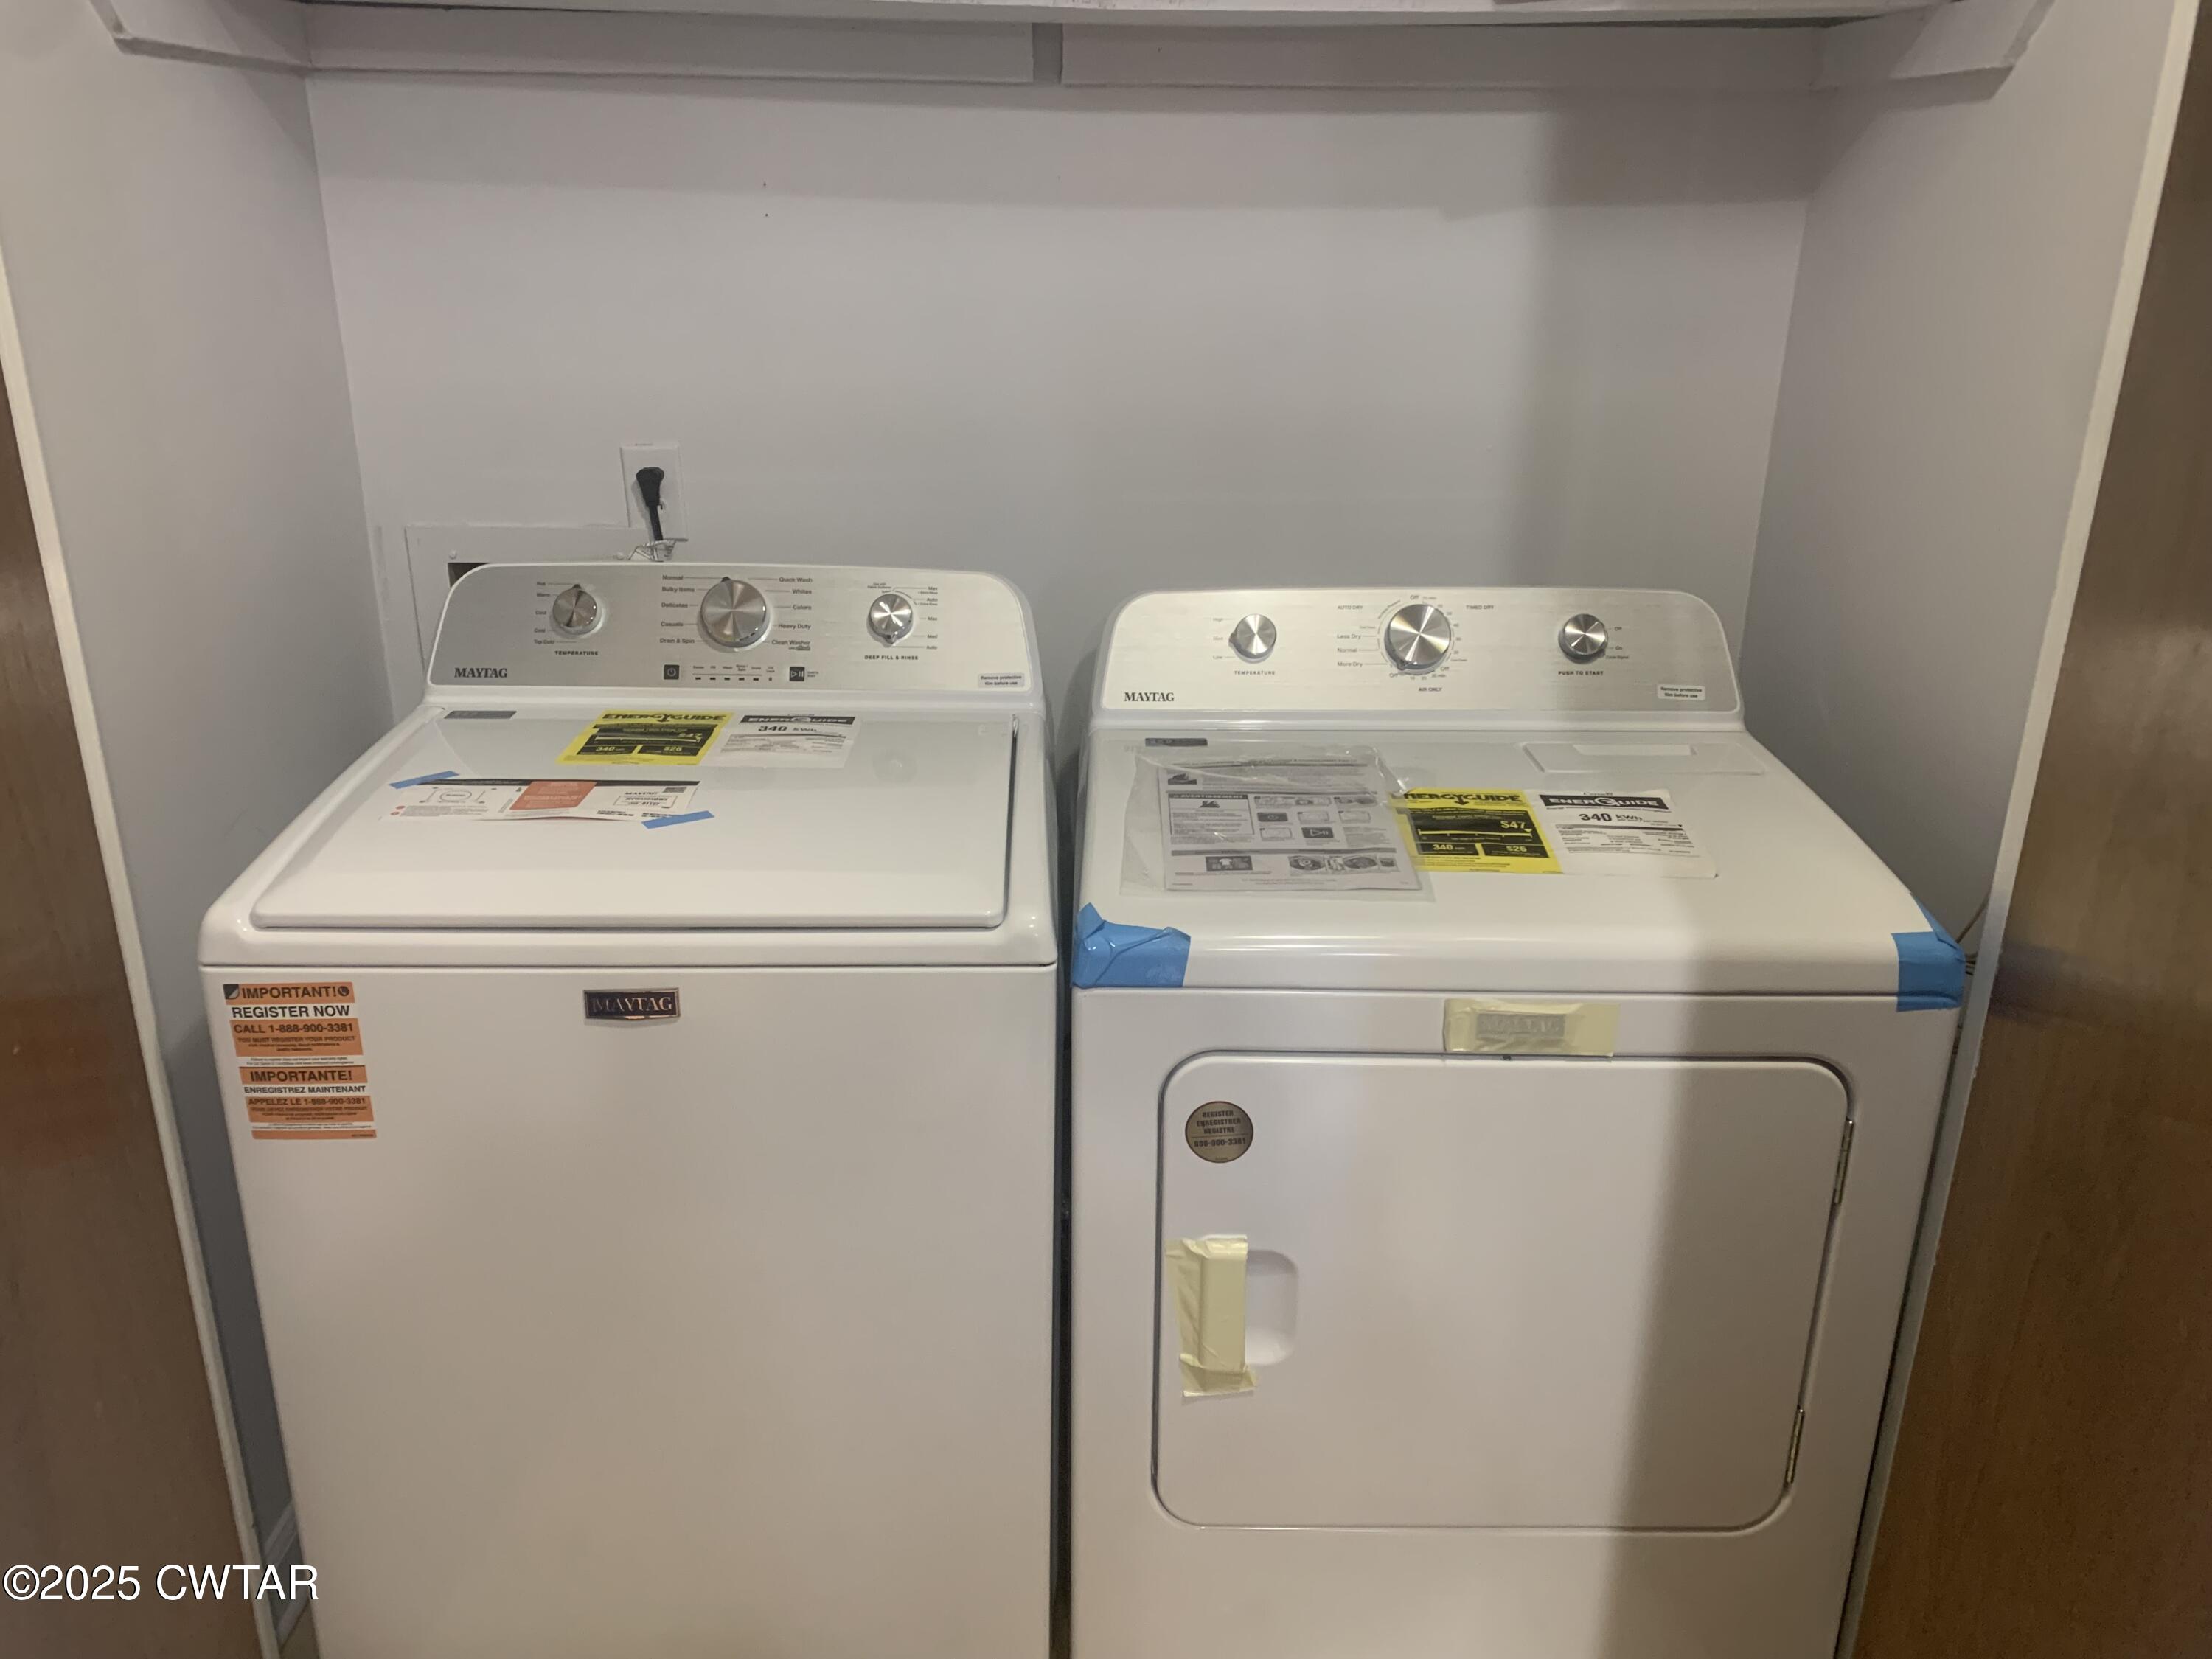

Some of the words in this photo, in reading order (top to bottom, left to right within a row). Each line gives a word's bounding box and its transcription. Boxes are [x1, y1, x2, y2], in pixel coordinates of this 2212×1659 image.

[454, 667, 507, 678] MAYTAG
[1124, 692, 1175, 701] MAYTAG
[602, 713, 726, 722] ENERGYGUIDE
[1579, 813, 1612, 821] 340
[1500, 821, 1525, 829] $47
[242, 986, 336, 998] IMPORTANT!
[592, 997, 672, 1012] MAYTAG
[232, 1006, 309, 1018] REGISTER
[314, 1005, 350, 1017] NOW
[234, 1024, 266, 1033] CALL
[269, 1023, 354, 1033] 1-888-900-3381
[251, 1071, 352, 1082] IMPORTANTE!
[1197, 1118, 1241, 1127] ENREGISTRER
[1194, 1138, 1246, 1147] 888-900-3381
